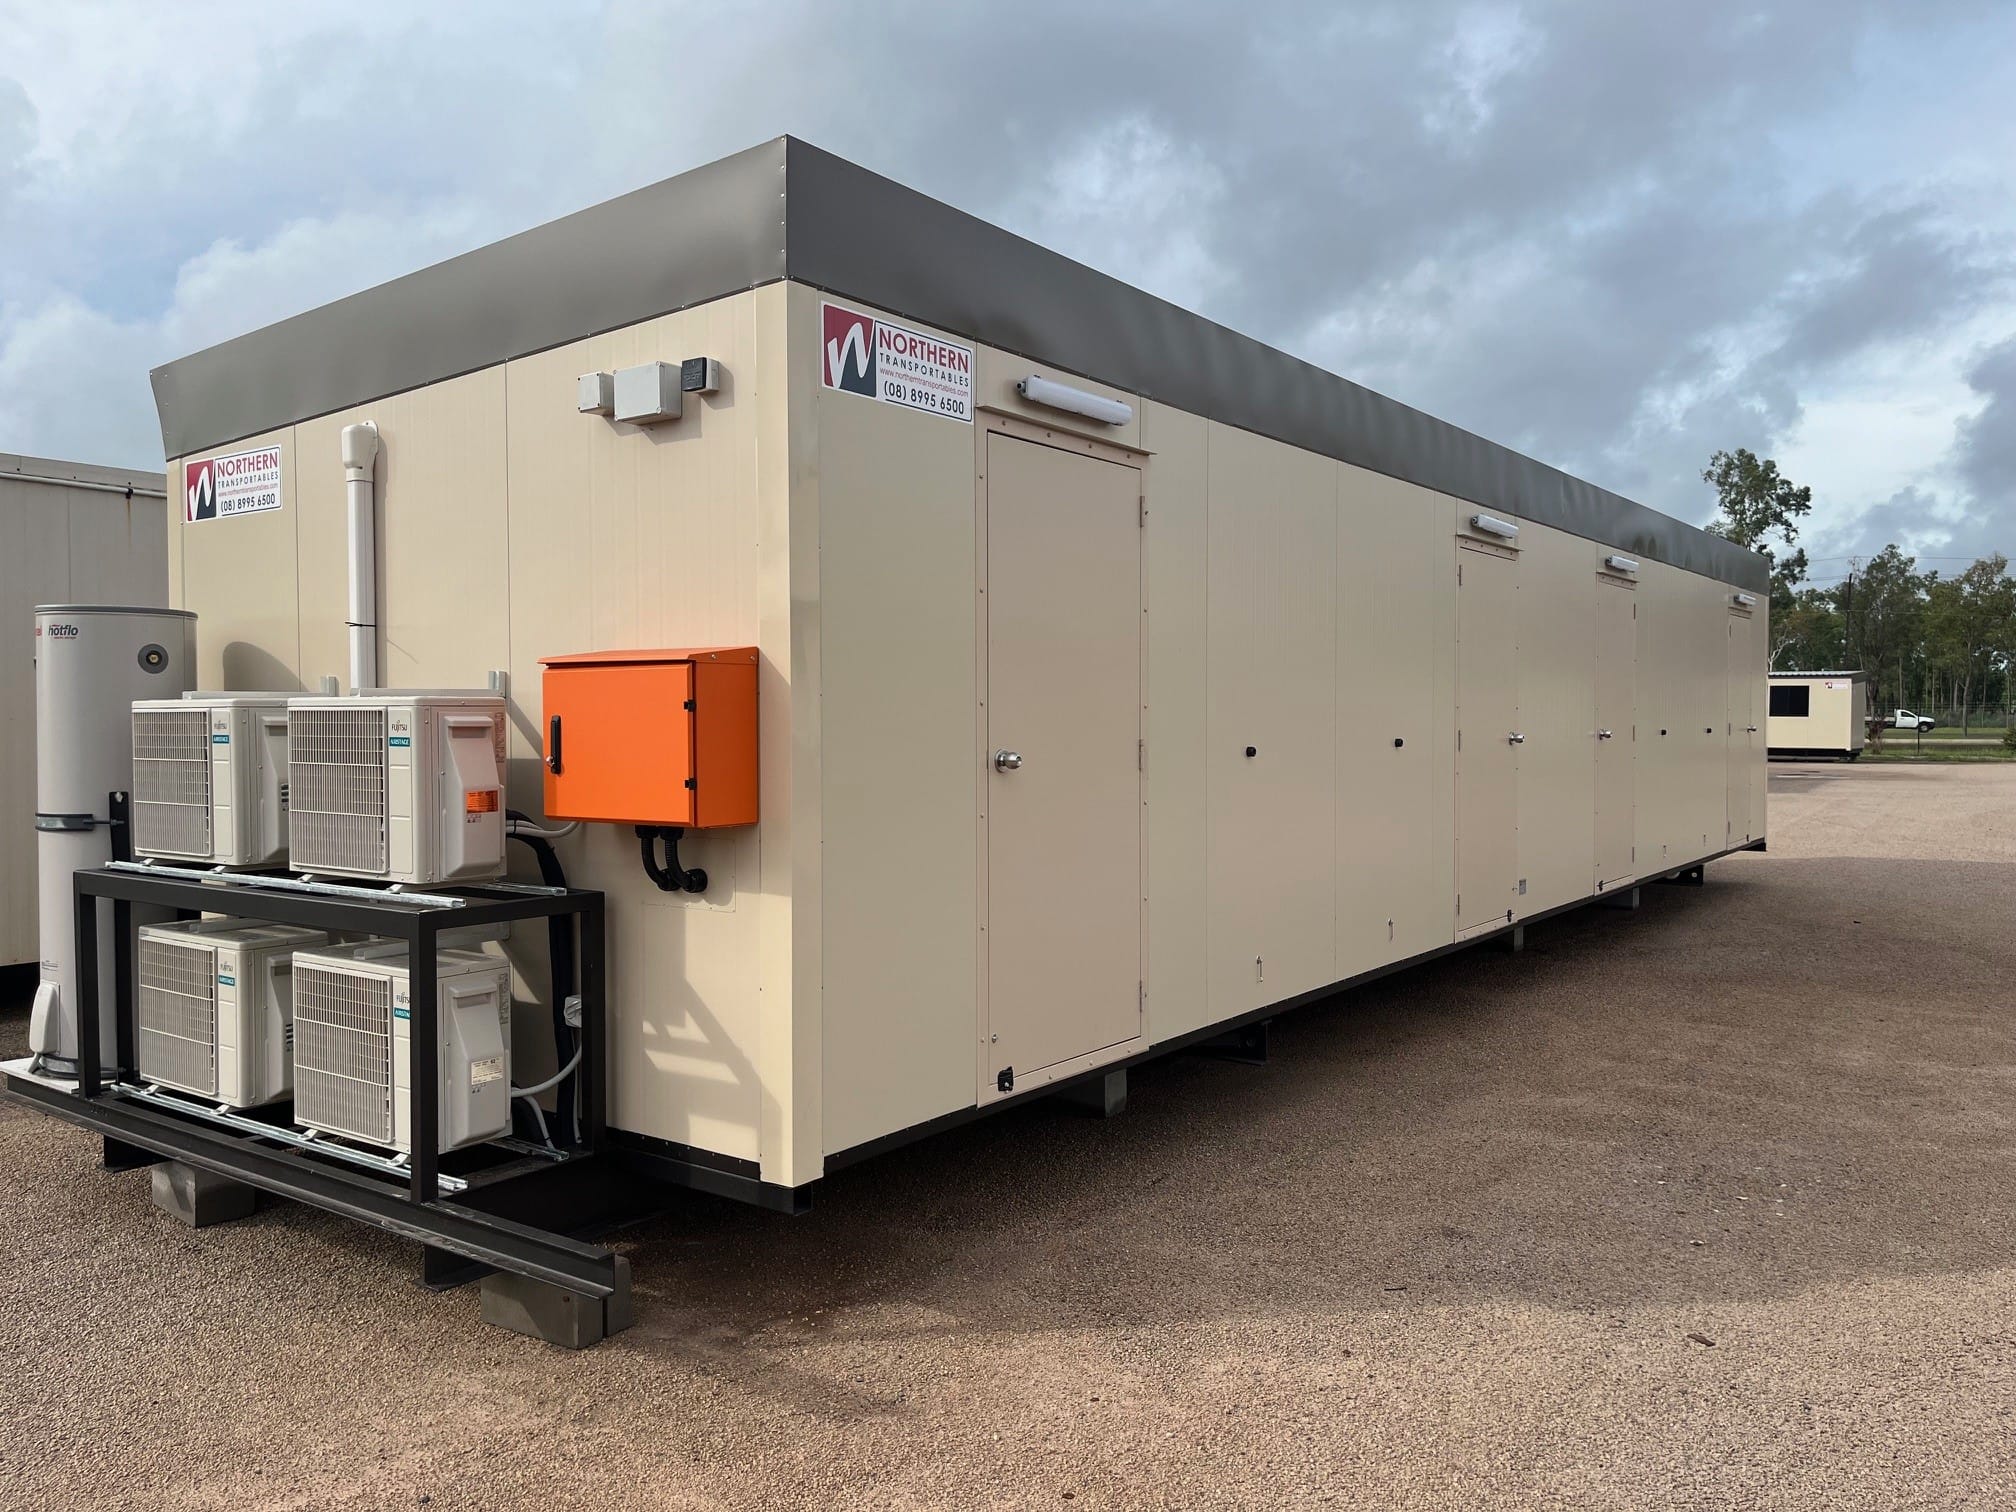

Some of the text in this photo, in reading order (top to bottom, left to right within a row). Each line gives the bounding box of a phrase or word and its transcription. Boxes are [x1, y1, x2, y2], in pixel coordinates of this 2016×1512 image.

[879, 327, 969, 374] NORTHERN
[879, 352, 969, 388] TRANSPORTABLES
[879, 367, 969, 397] www.northerntransportables.com
[884, 380, 964, 415] (08) 8995 6500
[217, 451, 278, 477] NORTHERN
[218, 471, 278, 489] TRANSPORTABLES
[220, 493, 276, 513] (08) 8995 6500
[48, 624, 79, 636] hotflo
[391, 720, 408, 732] FUJITSU
